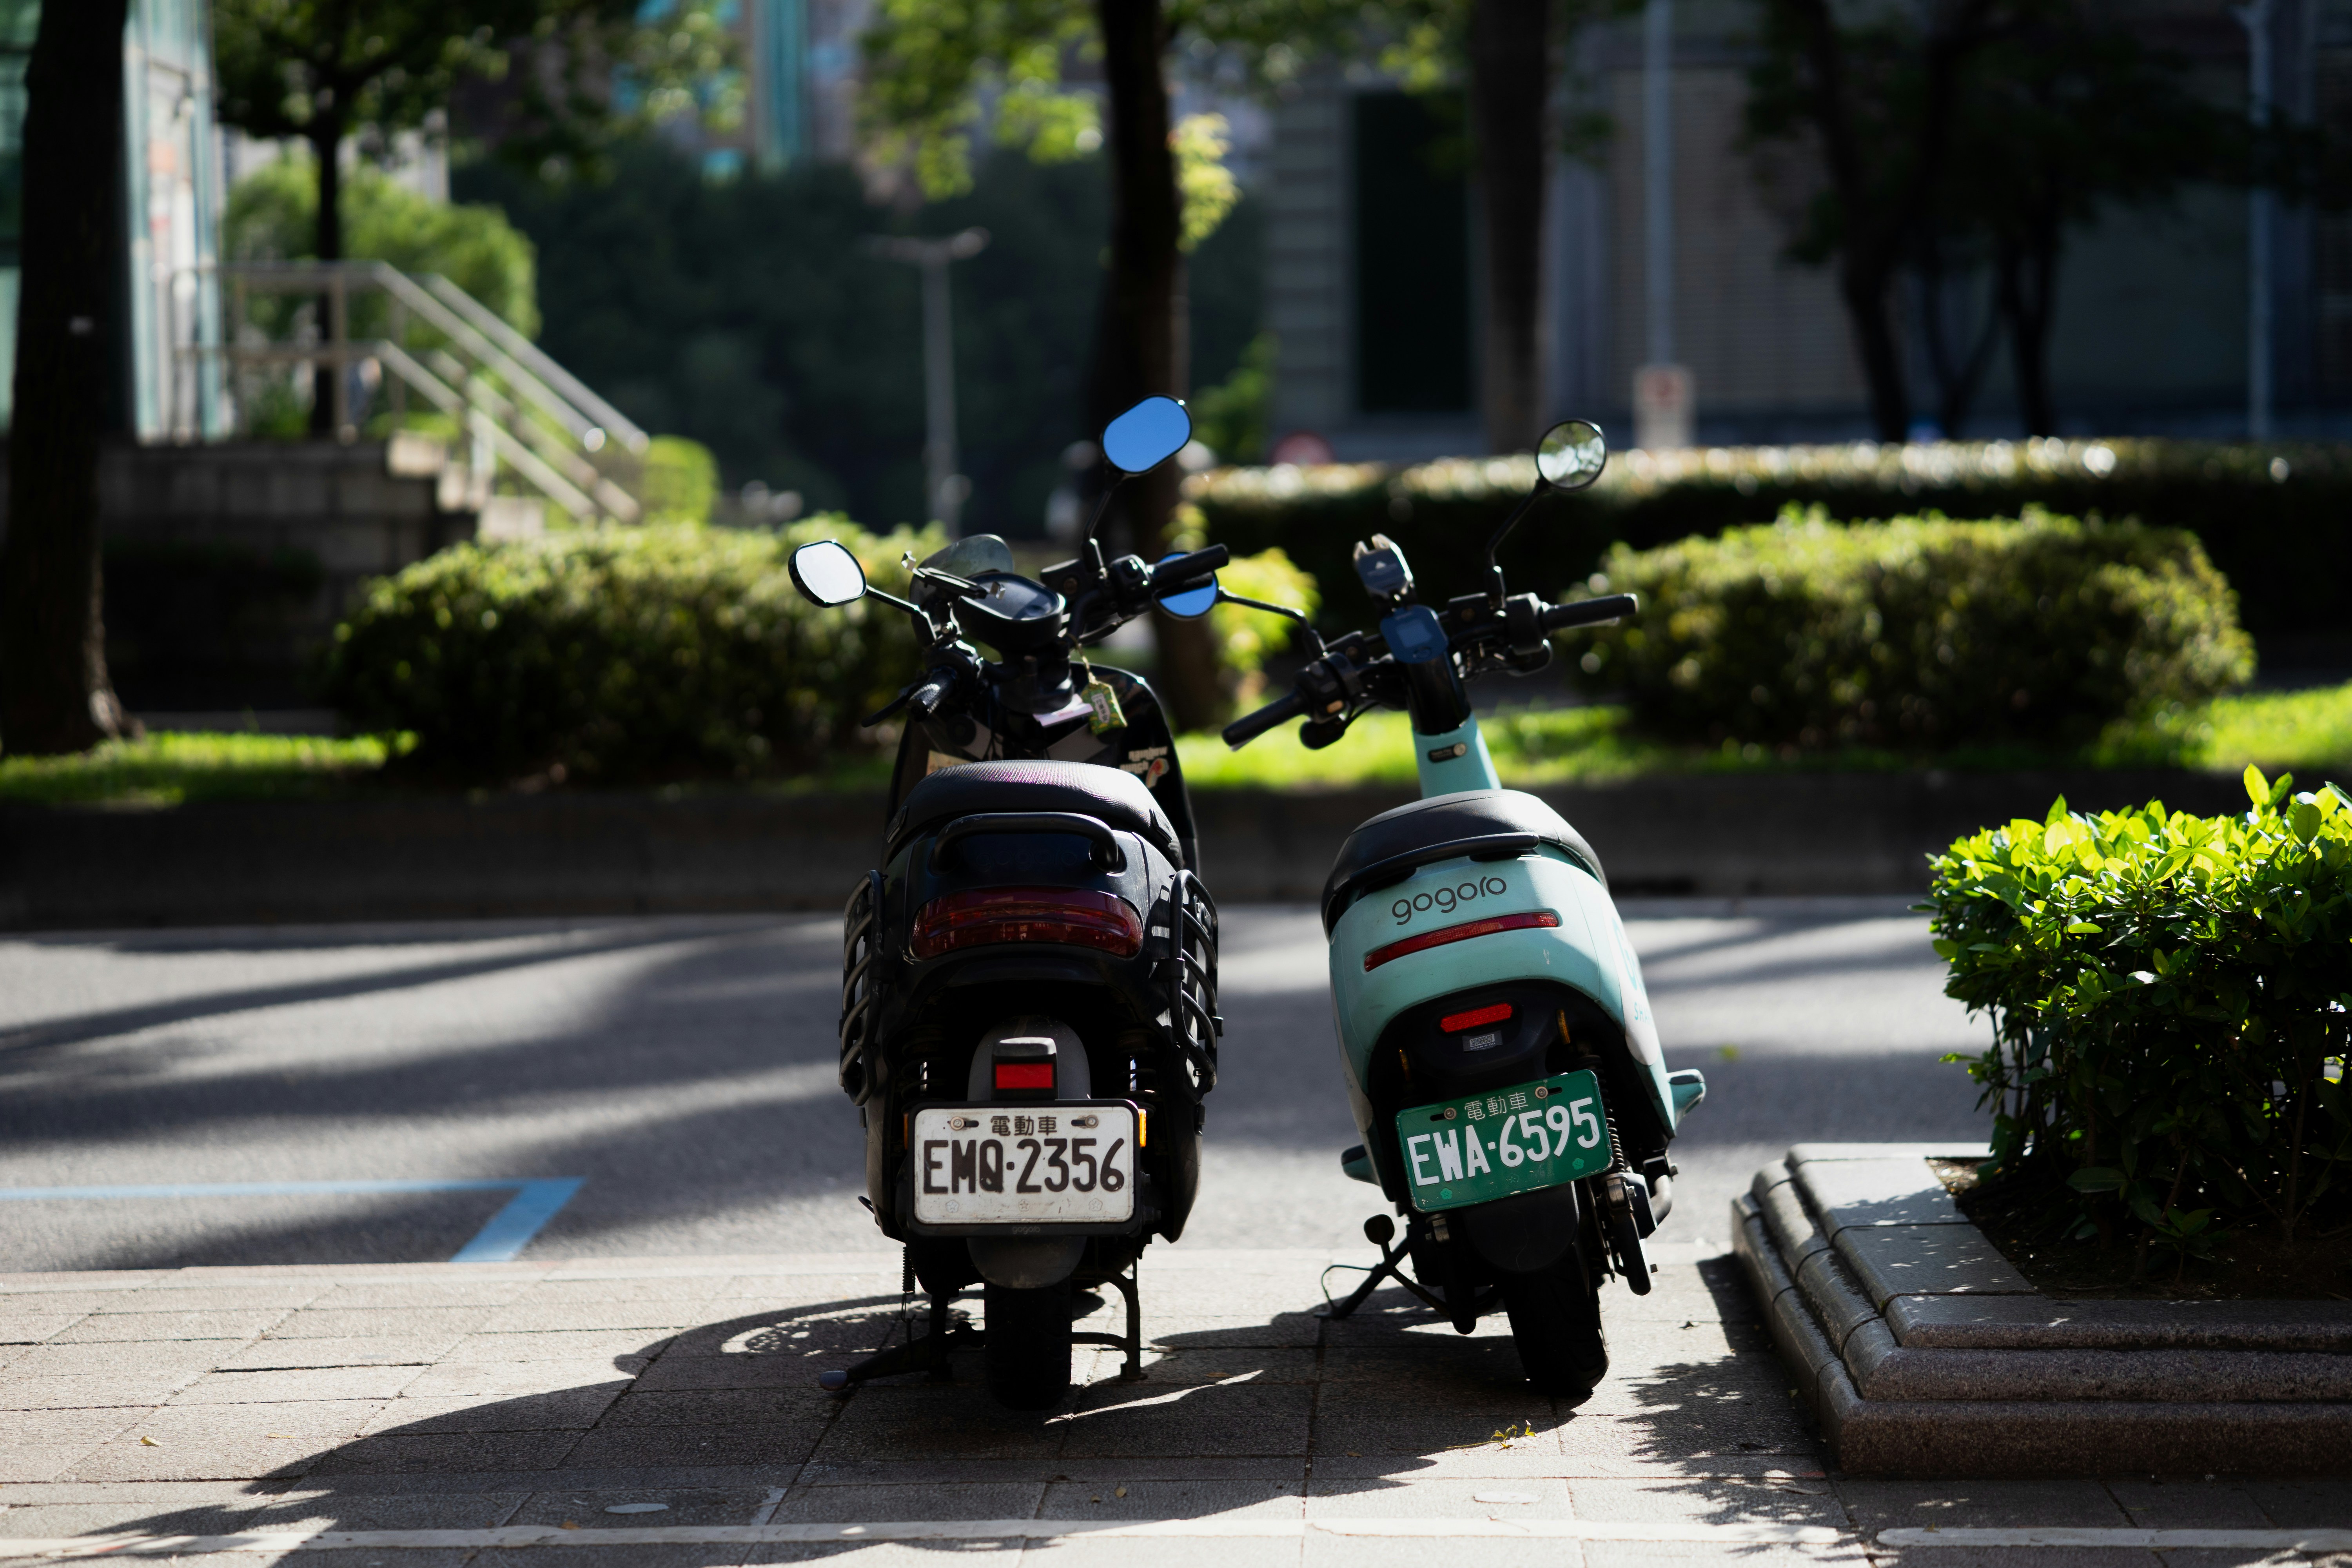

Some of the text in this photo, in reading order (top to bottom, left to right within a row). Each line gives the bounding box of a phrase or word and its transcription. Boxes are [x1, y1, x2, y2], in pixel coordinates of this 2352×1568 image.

[1392, 876, 1506, 926] gogoro
[1465, 1092, 1528, 1120] 電動車
[991, 1116, 1057, 1136] 電動車
[1012, 1226, 1040, 1234] gogoro
